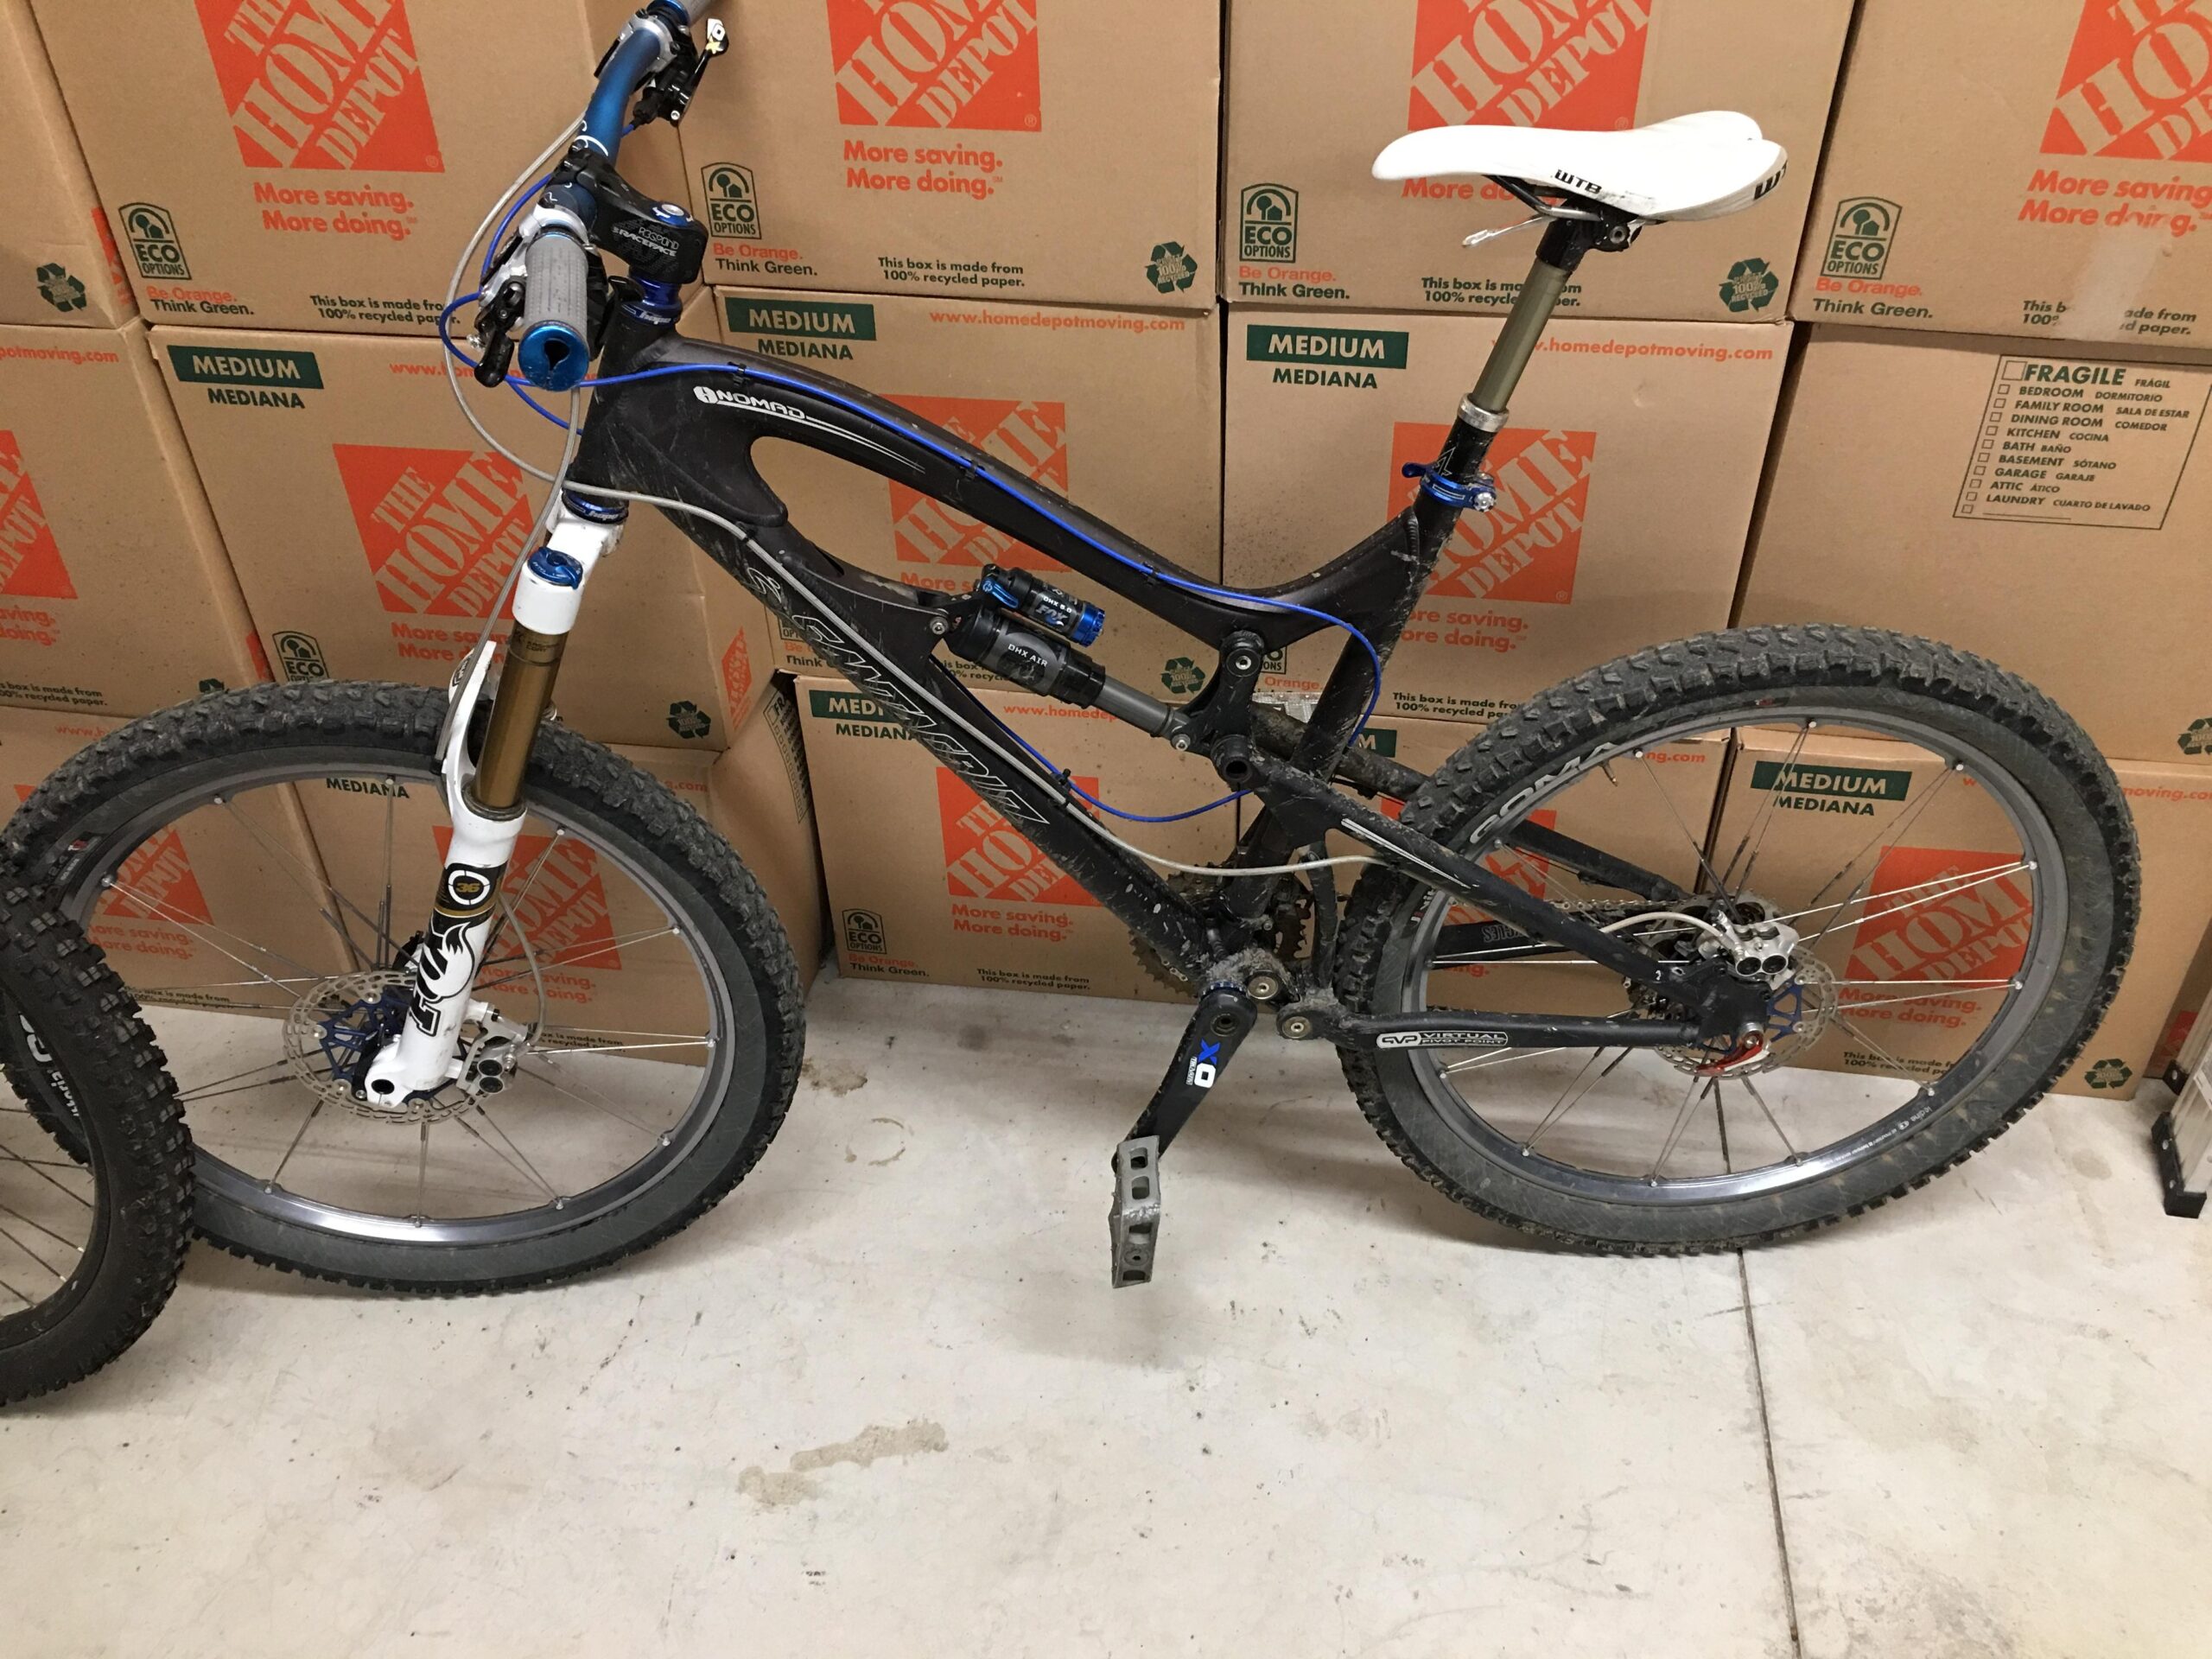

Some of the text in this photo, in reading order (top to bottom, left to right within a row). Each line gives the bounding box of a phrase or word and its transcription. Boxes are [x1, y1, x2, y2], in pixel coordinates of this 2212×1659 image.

[316, 28, 417, 171] DEPOT
[844, 139, 1003, 173] More saving.
[847, 168, 995, 200] More doing.
[1402, 179, 1473, 199] More
[1554, 169, 1602, 194] WTB
[2027, 169, 2109, 196] More
[254, 181, 413, 213] More saving.
[710, 203, 754, 222] ECO
[2018, 200, 2099, 225] More
[263, 210, 411, 240] More doing.
[714, 222, 756, 234] OPTIONS
[1245, 226, 1292, 245] ECO
[135, 245, 181, 263] ECO
[714, 243, 803, 260] Be Orange.
[1244, 245, 1291, 258] OPTIONS
[1831, 240, 1885, 261] ECO
[142, 263, 185, 276] OPTIONS
[715, 258, 817, 276] Think Green.
[878, 257, 1023, 274] This box is made from
[1827, 260, 1878, 275] OPTIONS
[883, 270, 1025, 289] 100% recycled paper.
[1239, 266, 1337, 284] Be Orange.
[1421, 277, 1497, 291] This box is
[147, 286, 237, 303] Be Orange.
[1239, 282, 1350, 300] Think Green.
[1816, 276, 1923, 299] Be Orange.
[310, 296, 420, 311] This box is made
[1425, 290, 1518, 305] 100% recycle
[149, 299, 254, 315] Think Green.
[318, 308, 413, 323] 100% recycled
[1814, 298, 1933, 318] Think Green.
[2023, 301, 2052, 313] This
[2158, 308, 2197, 322] from
[749, 308, 855, 334] MEDIUM
[930, 309, 1185, 334] www.homedepotmoving.com
[2139, 322, 2191, 336] paper.
[758, 339, 853, 360] MEDIANA
[1268, 334, 1384, 359] MEDIUM
[194, 354, 300, 379] MEDIUM
[1273, 367, 1377, 389] MEDIANA
[2024, 364, 2171, 389] FRAGILE FRÁGIL
[207, 387, 305, 409] MEDIANA
[2018, 386, 2163, 402] BEDROOM DORMITORIO
[718, 390, 805, 419] NOMAD
[2014, 400, 2190, 418] FAMILY ROOM SALA DE ESTAR
[2011, 414, 2167, 431] DINING ROOM COMEDOR
[2006, 428, 2109, 442] KITCHEN COCINA
[2003, 442, 2071, 454] BATH BAÑO
[1999, 454, 2116, 469] BASEMENT SÓTANO
[1994, 467, 2095, 481] GARAGE GARAJE
[1990, 480, 2060, 493] ATTIC ÁTICO
[371, 467, 435, 533] THE
[1986, 493, 2045, 505] LAUNDRY
[2053, 499, 2092, 508] CUARTO
[2109, 502, 2151, 512] LAVADO
[376, 452, 524, 612] HOME
[1457, 498, 1583, 598] DEPOT
[901, 572, 956, 591] More
[1043, 596, 1058, 607] DHX
[1446, 610, 1528, 632] saving.
[391, 622, 448, 639] More
[1445, 628, 1516, 652] doing.
[398, 643, 454, 659] More
[1008, 644, 1048, 668] DHX AIR
[287, 661, 325, 678] ECO
[956, 660, 978, 671] box
[1264, 676, 1321, 690] Orange.
[1393, 692, 1497, 708] This box is made
[1395, 702, 1429, 713] 100%
[1433, 703, 1484, 718] recycled
[327, 778, 410, 798] MEDIANA
[1776, 771, 1886, 795] MEDIUM
[1773, 795, 1875, 816] MEDIANA
[456, 883, 480, 893] 36
[952, 904, 1073, 928] More saving.
[849, 931, 881, 944] ECO
[953, 918, 1066, 942] More doing.
[850, 963, 930, 977] Think Green.
[976, 968, 1090, 983] This box is made from
[981, 975, 1090, 990] 100% recycled paper.
[1897, 1007, 1967, 1028] doing.
[1843, 1051, 1865, 1060] This
[1907, 1057, 1942, 1067] made
[1844, 1058, 1877, 1067] 100%
